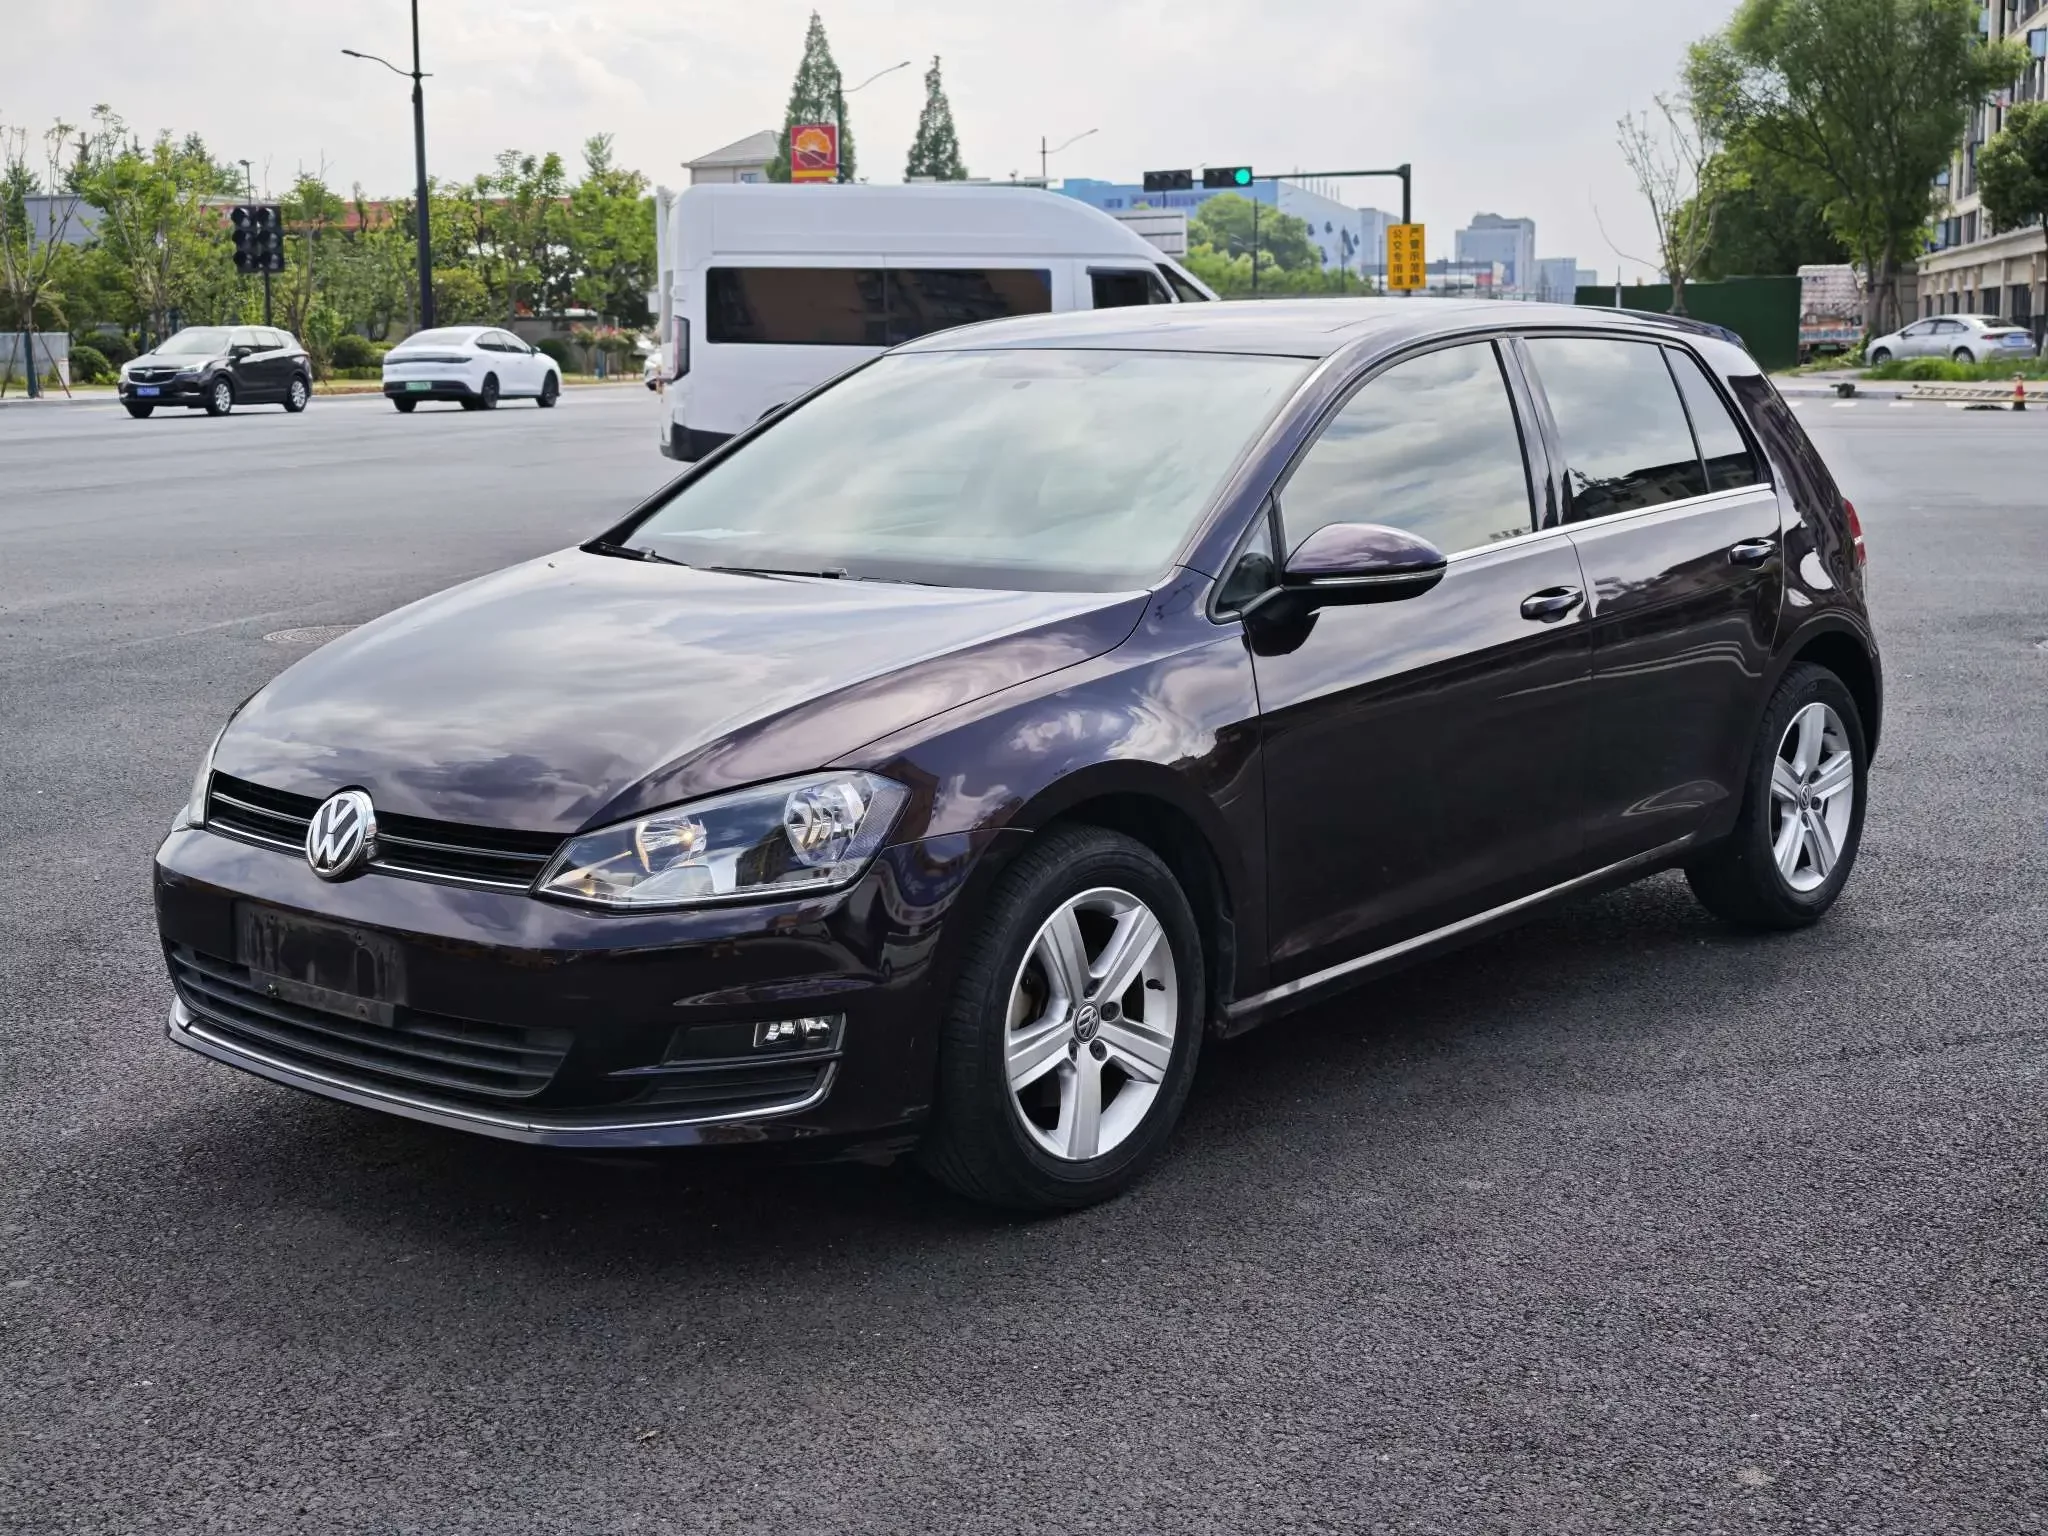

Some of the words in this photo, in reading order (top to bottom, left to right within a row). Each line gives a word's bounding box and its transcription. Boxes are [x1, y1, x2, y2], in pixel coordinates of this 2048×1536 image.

[1392, 228, 1404, 286] 公交专用道
[307, 792, 369, 873] VW
